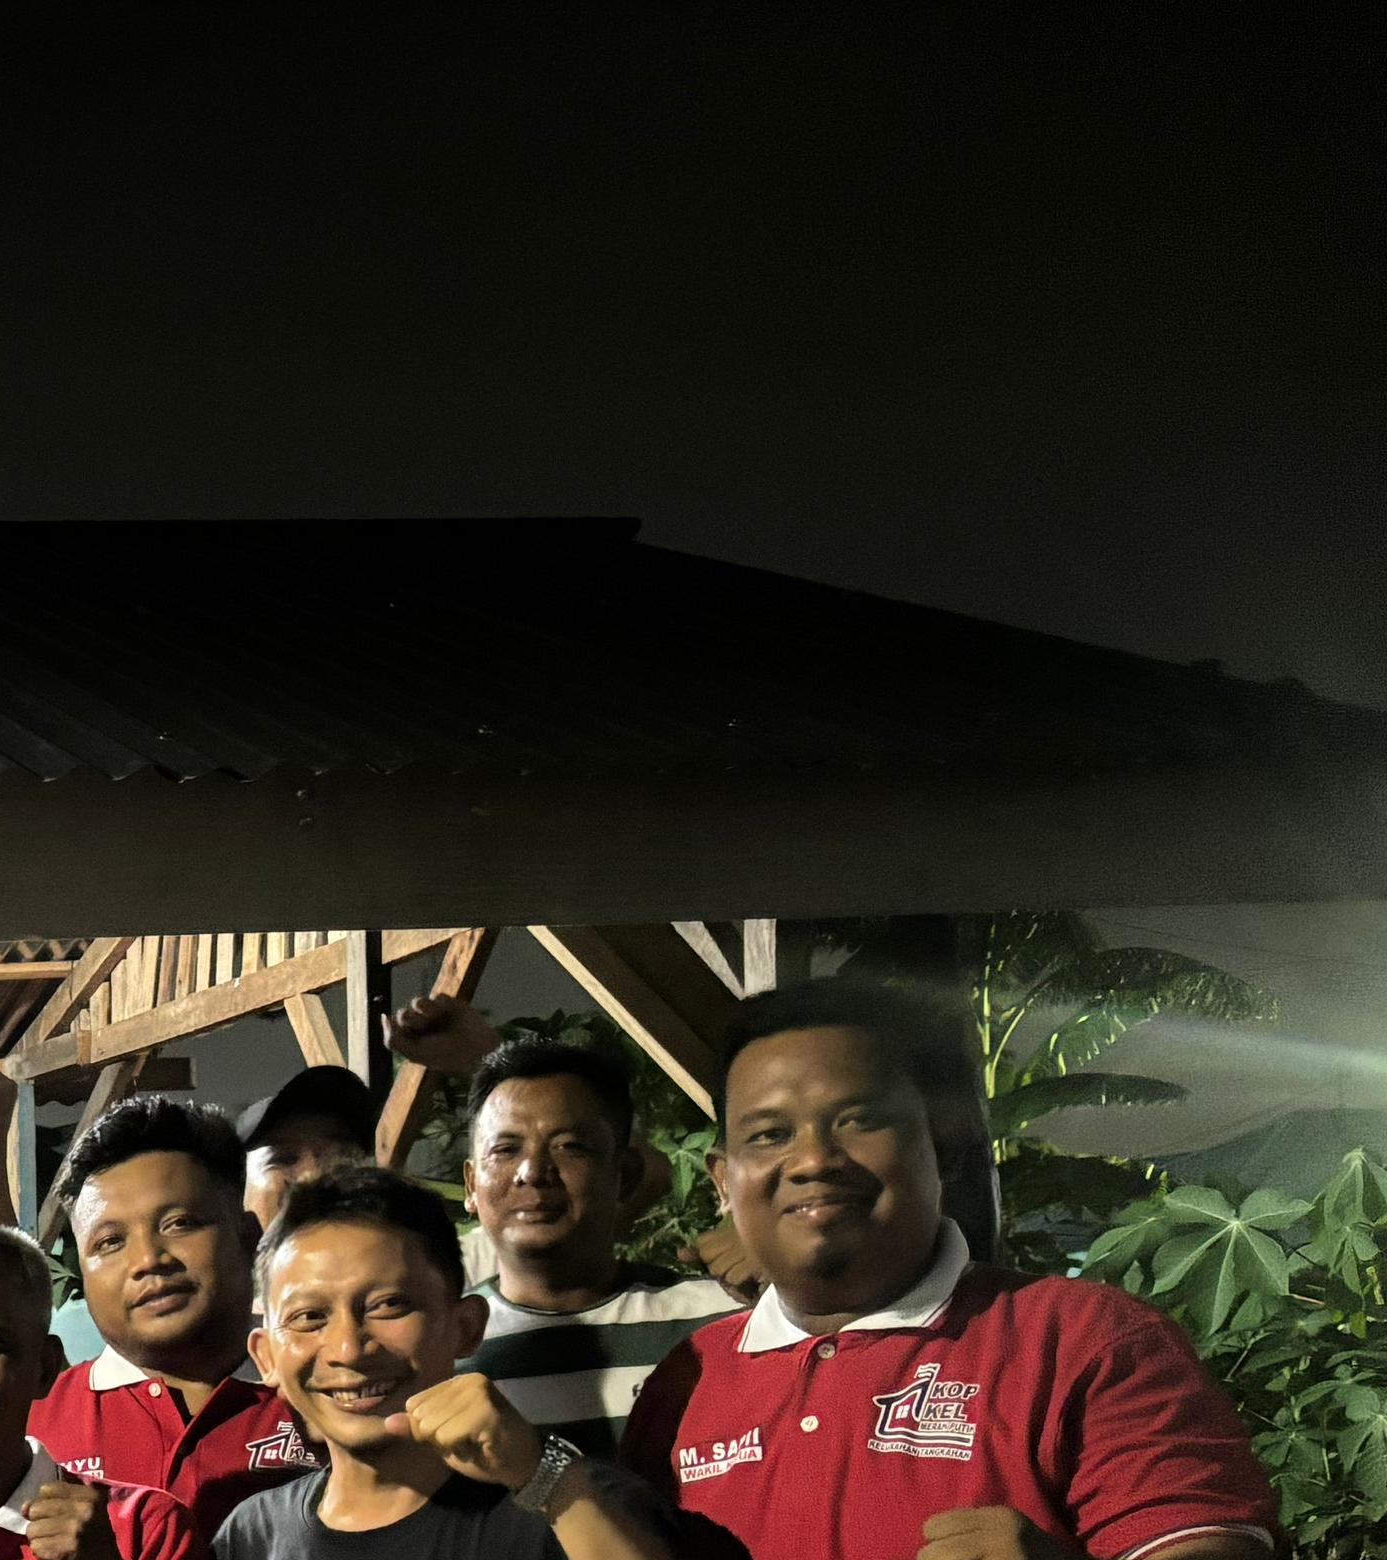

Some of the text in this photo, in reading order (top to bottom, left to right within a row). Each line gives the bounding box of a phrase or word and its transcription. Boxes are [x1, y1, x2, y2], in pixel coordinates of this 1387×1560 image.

[930, 1380, 981, 1401] KOP
[922, 1402, 968, 1421] KEL
[679, 1447, 706, 1467] M.
[683, 1464, 723, 1480] WAKIL
